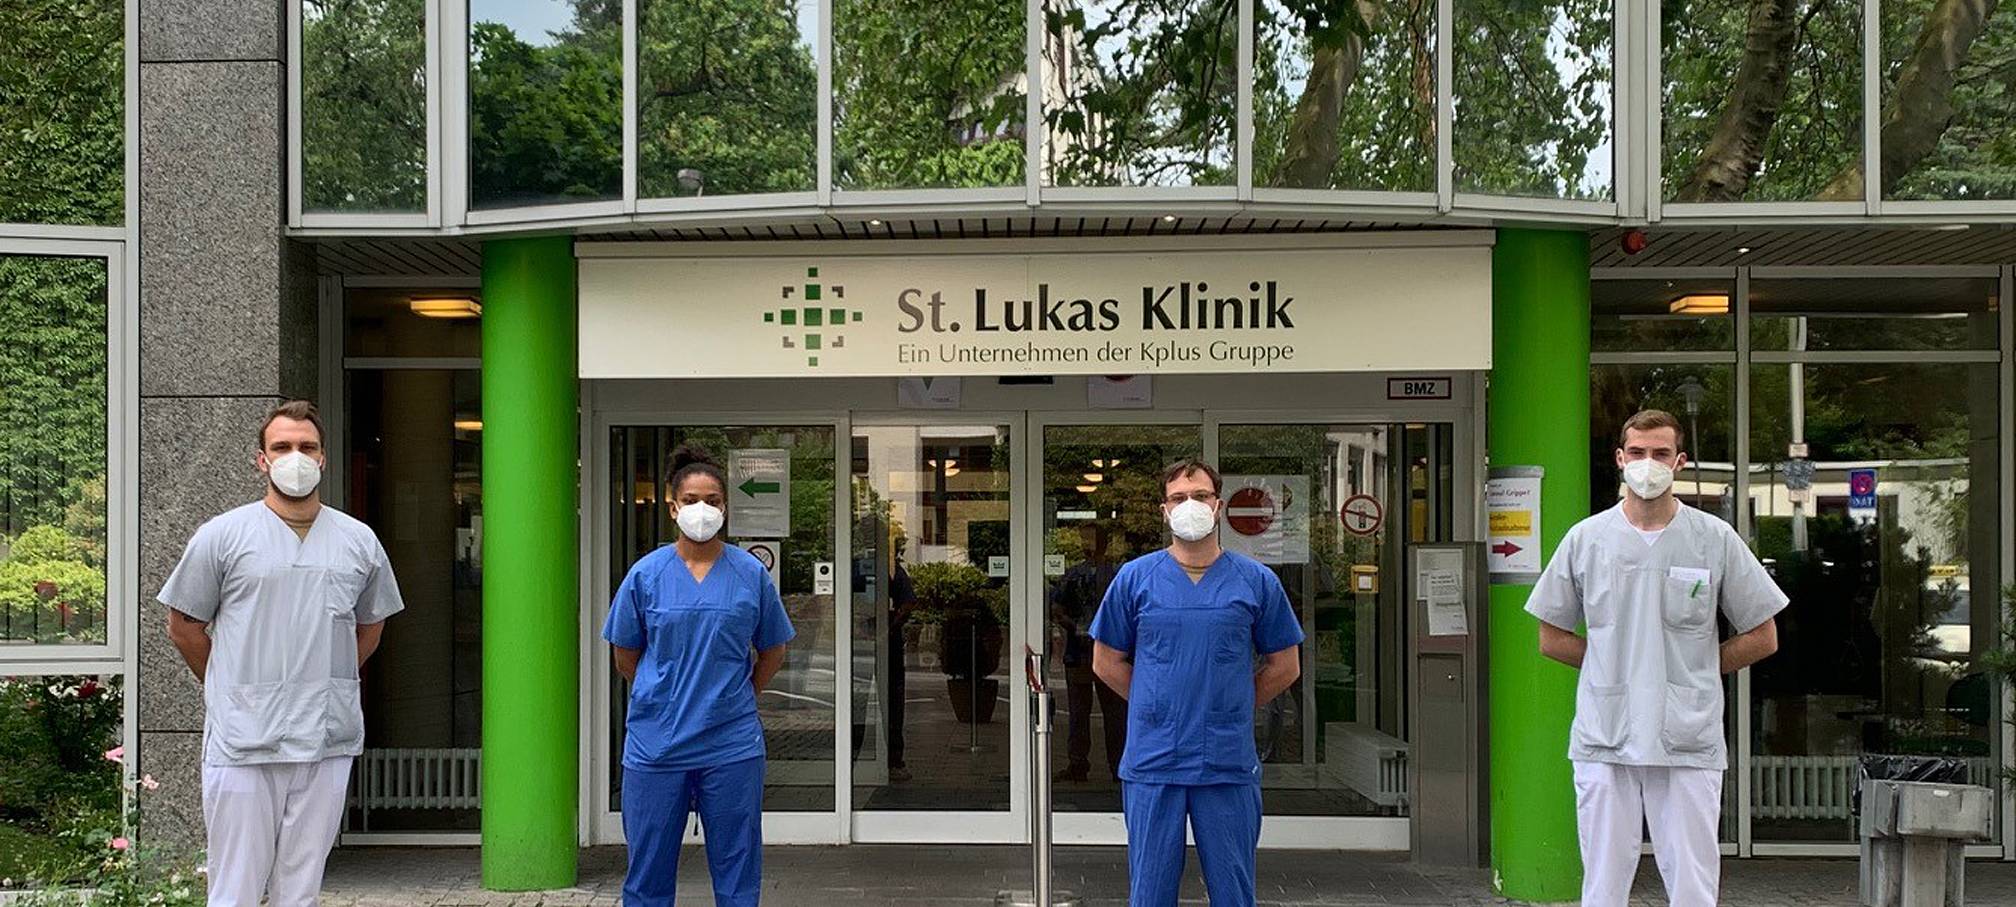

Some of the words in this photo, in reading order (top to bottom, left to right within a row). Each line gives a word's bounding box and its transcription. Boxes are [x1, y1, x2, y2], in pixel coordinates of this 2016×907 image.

[898, 288, 961, 333] St.
[974, 283, 1120, 333] Lukas
[1142, 280, 1295, 331] Klinik
[898, 343, 930, 363] Ein
[939, 341, 1089, 363] Unternehmen
[1096, 341, 1133, 363] der
[1141, 340, 1202, 368] Kplus
[1209, 340, 1295, 368] Gruppe
[1404, 382, 1435, 395] BMZ
